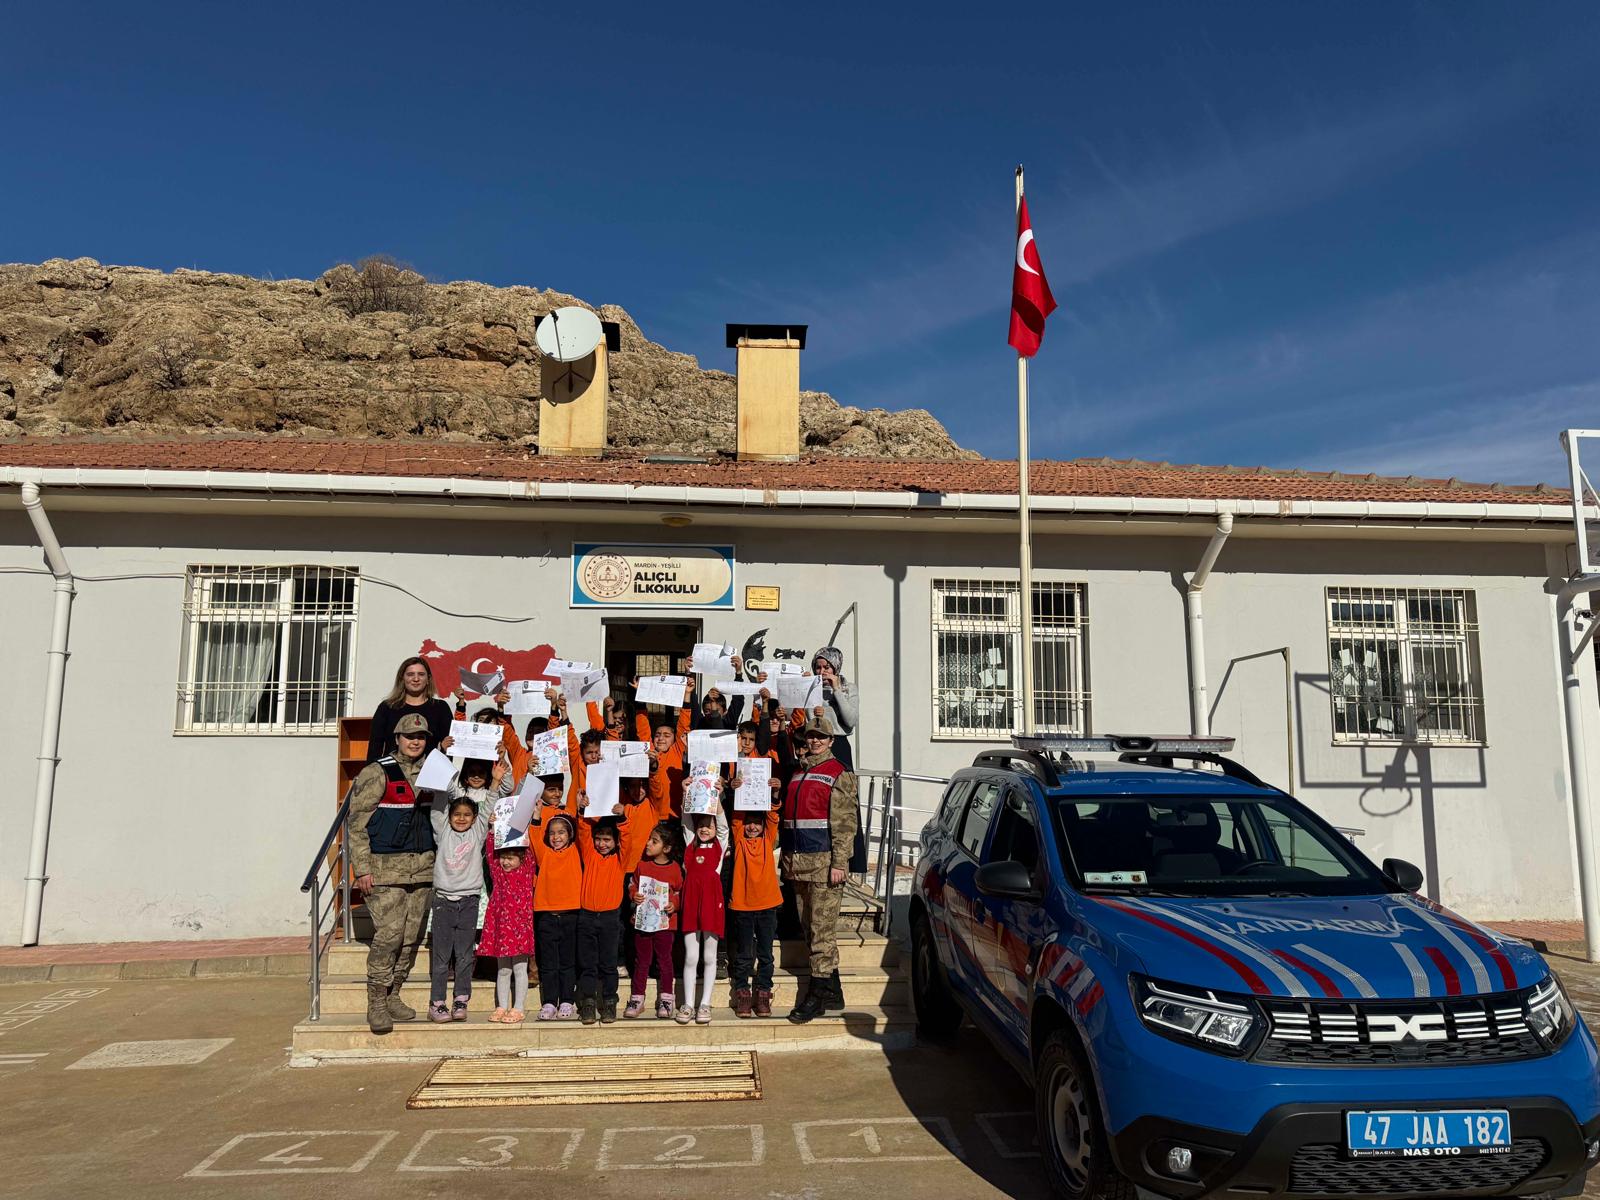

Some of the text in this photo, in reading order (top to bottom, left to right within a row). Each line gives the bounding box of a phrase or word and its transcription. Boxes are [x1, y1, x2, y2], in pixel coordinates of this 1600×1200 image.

[634, 572, 677, 583] ALIÇLI
[634, 582, 700, 593] İLKOKULU
[1217, 918, 1424, 935] JANDARMA
[848, 1126, 881, 1153] 1
[1364, 1116, 1505, 1145] 47 JAA 182
[258, 1140, 324, 1164] 4
[457, 1135, 519, 1166] 3
[654, 1135, 704, 1161] 2
[1403, 1147, 1461, 1156] NAS OTO
